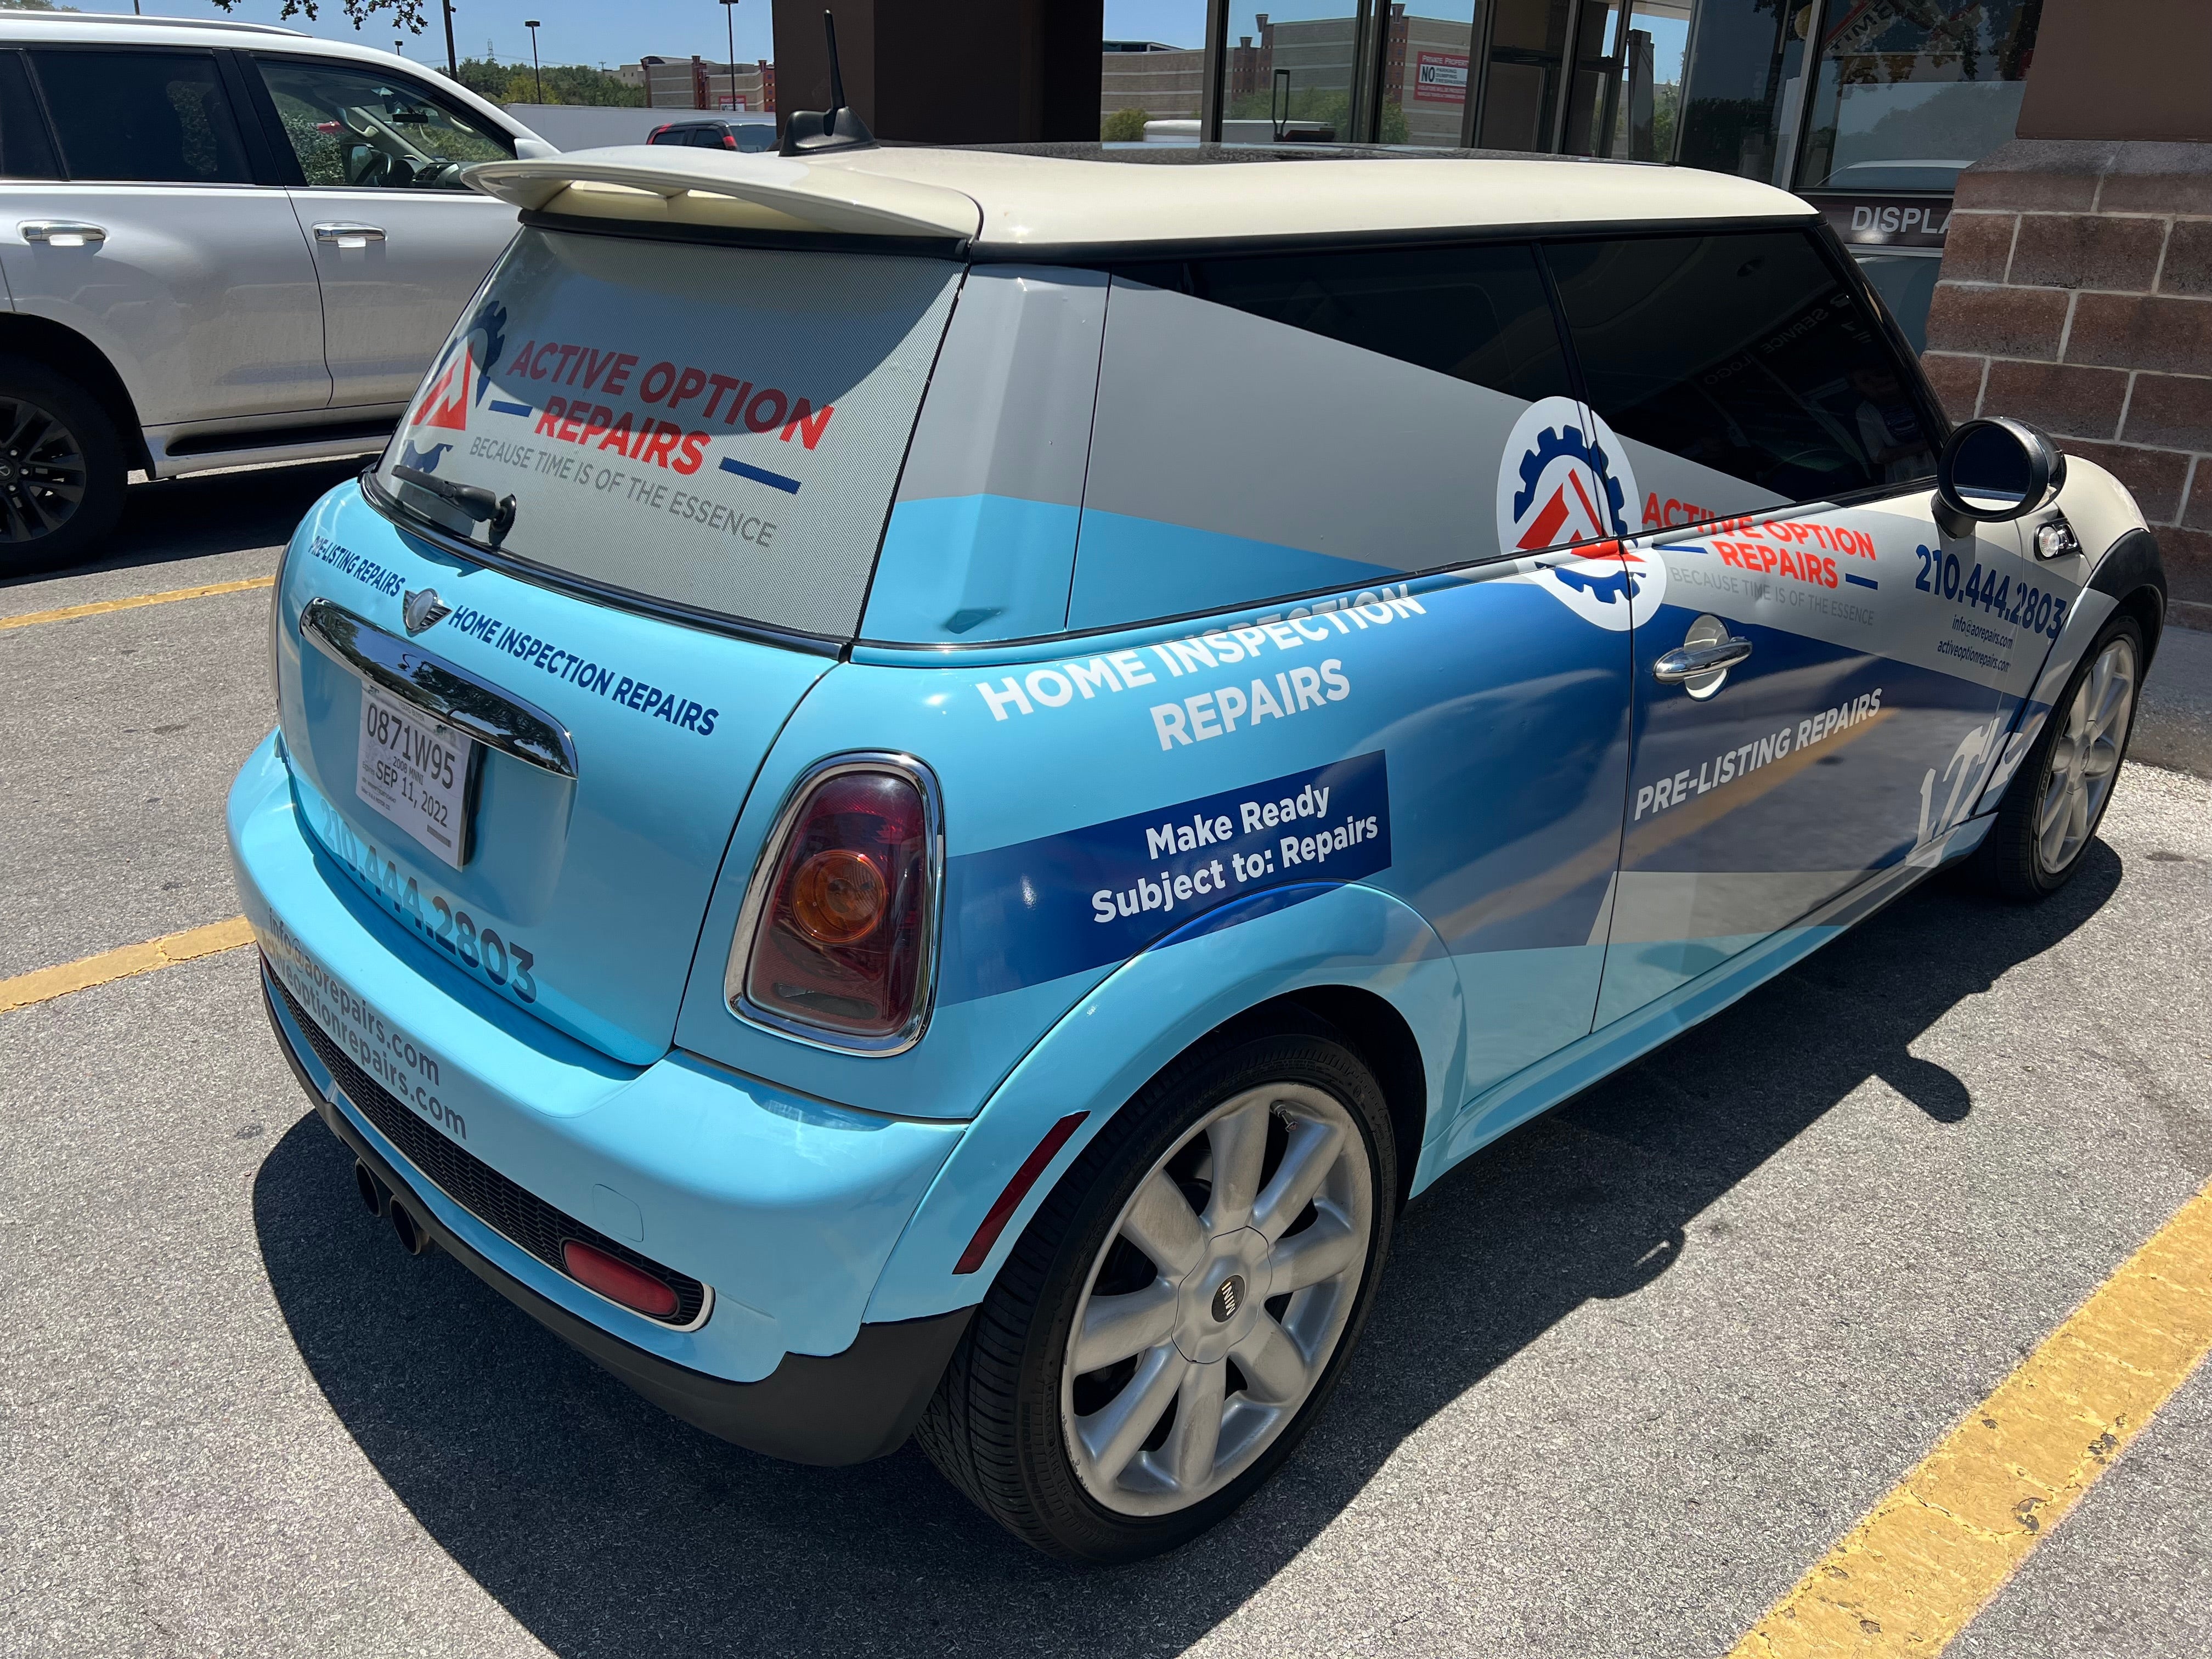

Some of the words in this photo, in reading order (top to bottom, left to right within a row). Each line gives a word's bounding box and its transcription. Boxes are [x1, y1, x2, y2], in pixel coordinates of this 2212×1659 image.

[1421, 66, 1435, 82] NO
[507, 340, 639, 396] ACTIVE
[640, 361, 834, 450] OPTION
[534, 396, 712, 476] REPAIRS
[469, 436, 533, 470] BECAUSE
[535, 450, 573, 480] TIME
[574, 462, 592, 486] IS
[595, 470, 624, 497] OF
[629, 476, 666, 511] THE
[668, 492, 777, 548] ESSENCE
[1641, 492, 1764, 539] ACTIVE
[1762, 520, 1877, 561] OPTION
[308, 535, 360, 574] PRE-LISTING
[353, 558, 406, 597] REPAIRS
[1669, 566, 1740, 594] BECAUSE
[1742, 580, 1771, 602] TIME
[1775, 586, 1786, 604] IS
[1790, 590, 1805, 607] OF
[1808, 594, 1829, 615] THE
[1831, 601, 1875, 627] ESSENCE
[1711, 540, 1839, 589] REPAIRS
[1915, 544, 2068, 640] 210.444.2803
[448, 605, 501, 645] HOME
[495, 626, 616, 697] INSPECTION
[611, 675, 720, 737] REPAIRS
[975, 649, 1156, 722] HOME
[1149, 583, 1427, 678] INSPECTION
[1951, 614, 2014, 650] info@aorepairs.com
[366, 702, 456, 790] 0871W95
[1149, 658, 1351, 752] REPAIRS
[375, 759, 398, 788] SEP
[401, 776, 418, 809] 11,
[420, 790, 448, 829] 2022
[393, 755, 408, 774] 2008
[1634, 727, 1793, 821] PRE-LISTING
[1795, 687, 1883, 752] REPAIRS
[1146, 812, 1233, 861] Make
[1240, 784, 1330, 834] Ready
[320, 798, 537, 1004] 210.444.2803
[1091, 858, 1226, 924] Subject
[1232, 848, 1276, 884] to:
[1281, 814, 1379, 869] Repairs
[269, 907, 440, 1086] info@aorepairs.com
[1221, 1281, 1235, 1316] MINI
